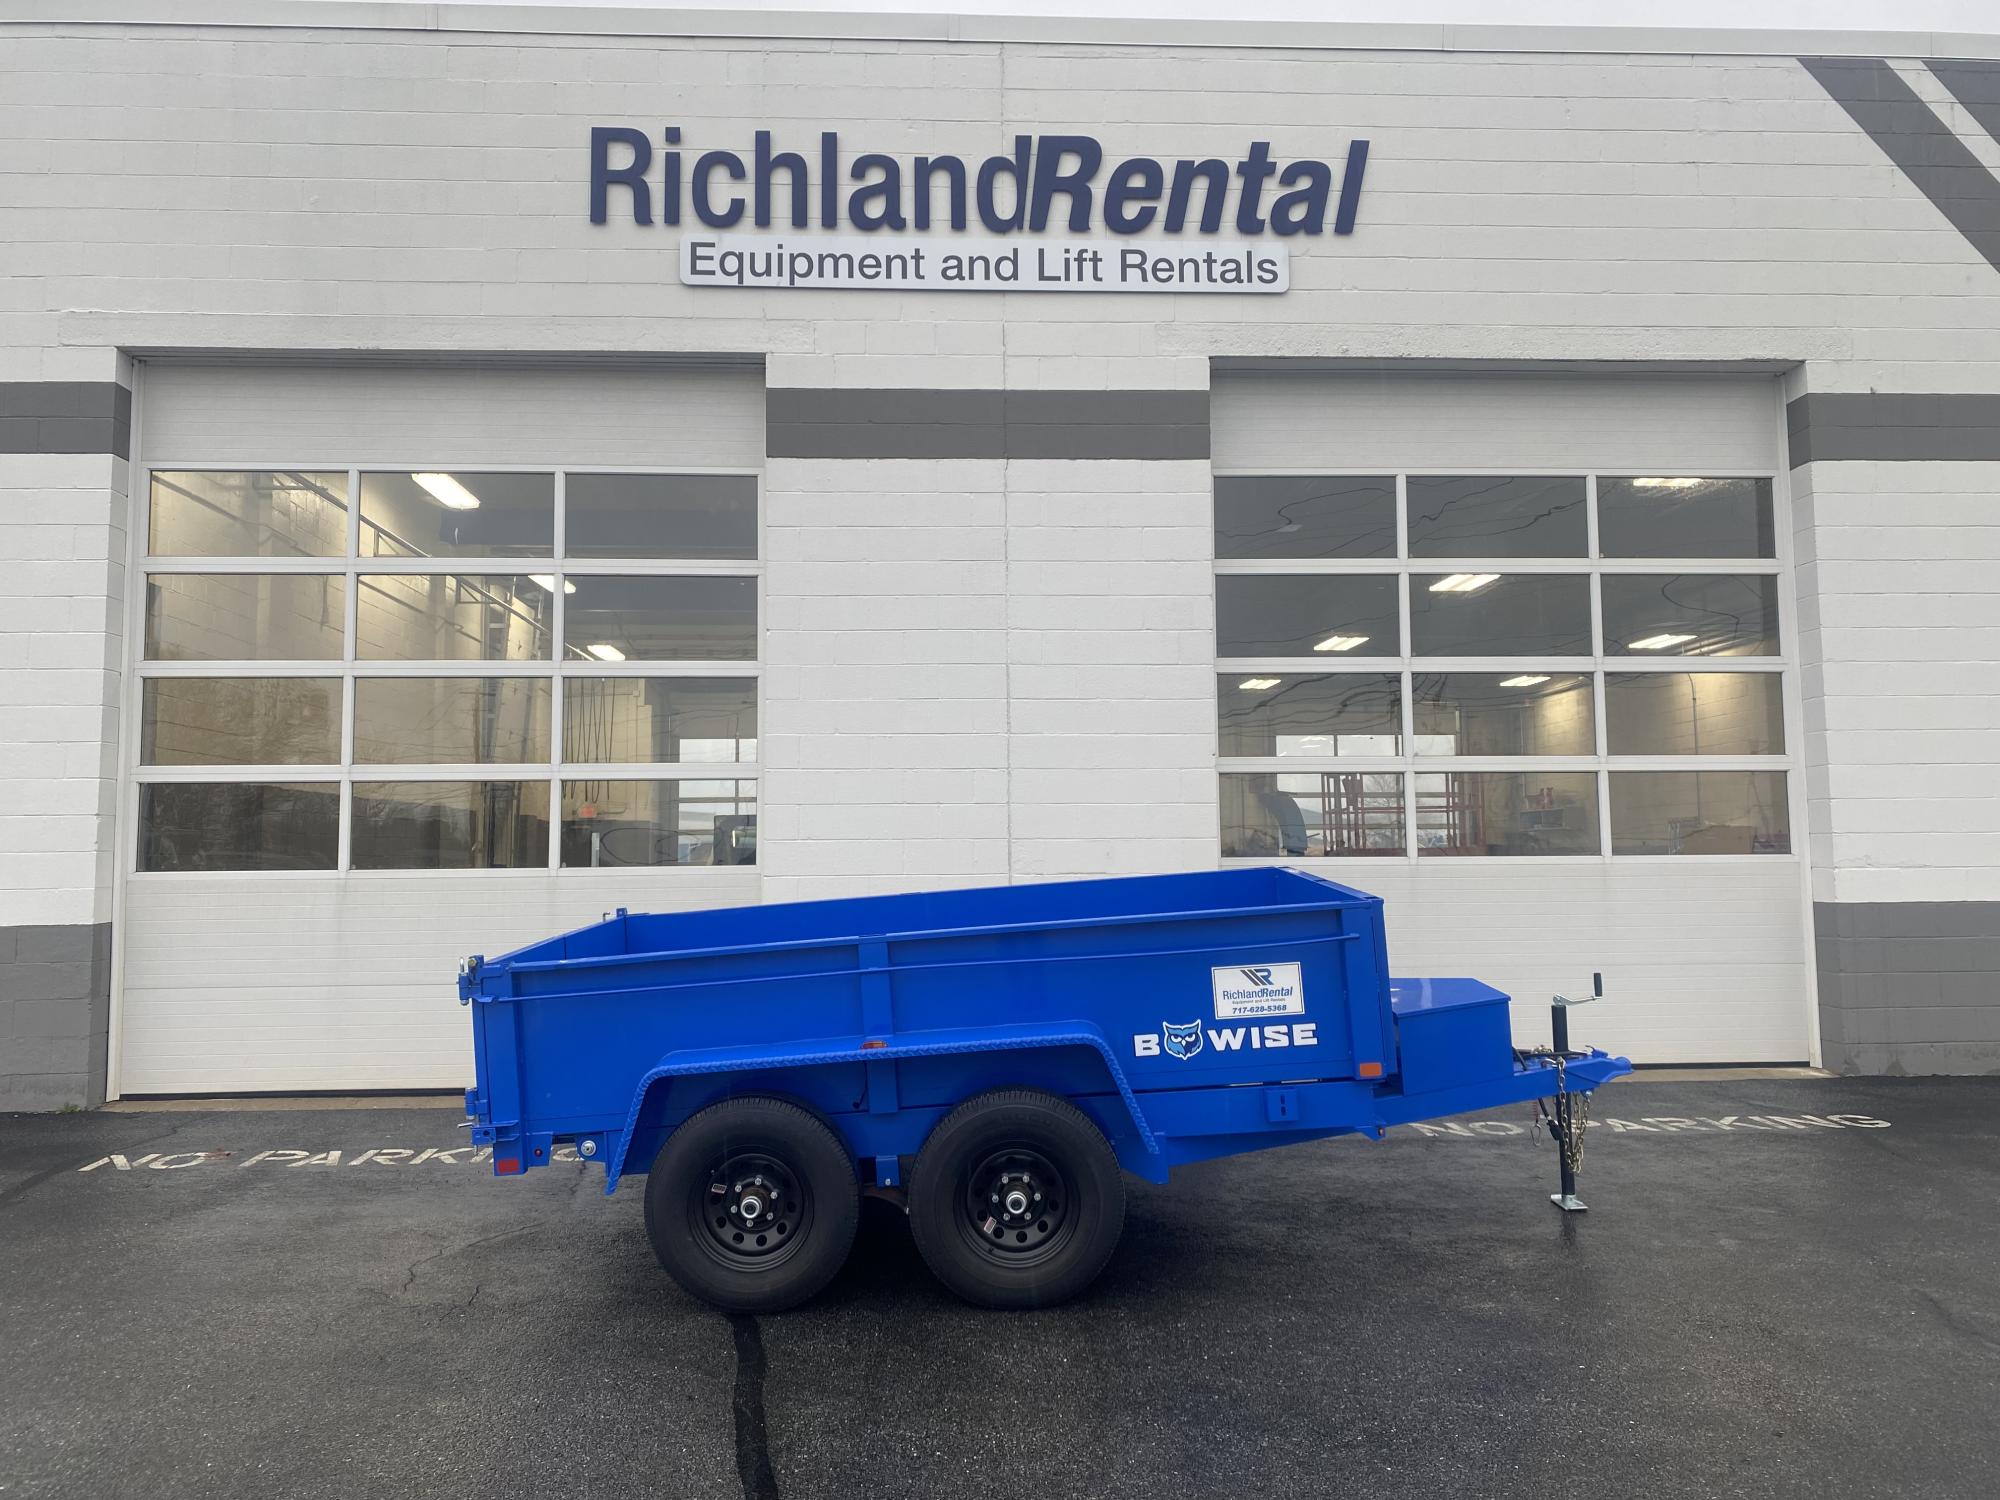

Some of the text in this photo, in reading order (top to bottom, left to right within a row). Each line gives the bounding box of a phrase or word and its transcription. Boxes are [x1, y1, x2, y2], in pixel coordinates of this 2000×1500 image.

[690, 241, 1280, 286] Equipment and Lift Rentals
[1232, 1004, 1287, 1015] 717-628-5368
[1407, 1120, 1526, 1137] NO
[77, 1147, 588, 1172] NO PARKIG
